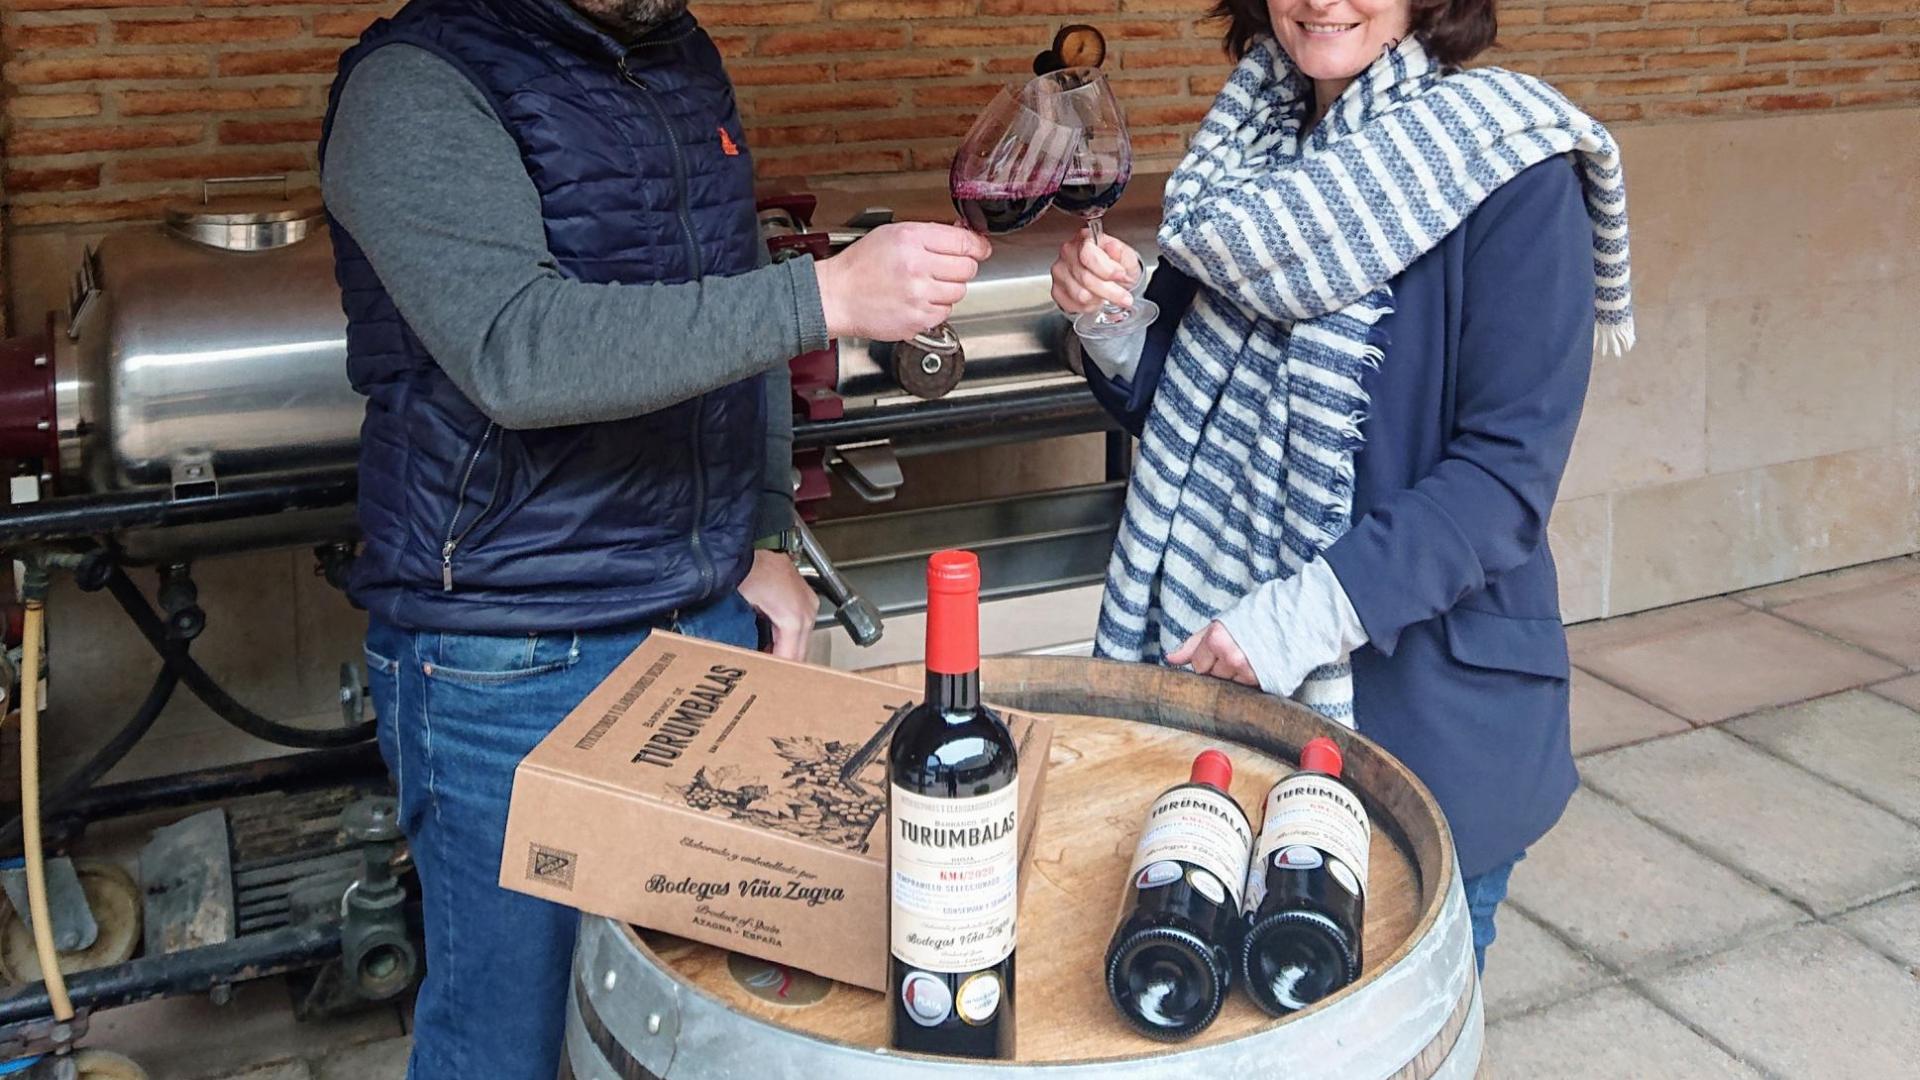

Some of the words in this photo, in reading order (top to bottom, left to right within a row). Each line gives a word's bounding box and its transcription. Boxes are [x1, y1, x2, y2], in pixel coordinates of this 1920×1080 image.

[631, 665, 747, 768] TURUMBALAS
[898, 811, 1016, 848] TURUMBALAS
[645, 874, 731, 901] Bodegas
[738, 878, 783, 898] Viña
[782, 881, 845, 907] Zagra
[692, 916, 732, 934] AZAGRA
[742, 930, 783, 948] ESPAÑA
[906, 933, 955, 950] Bodegas
